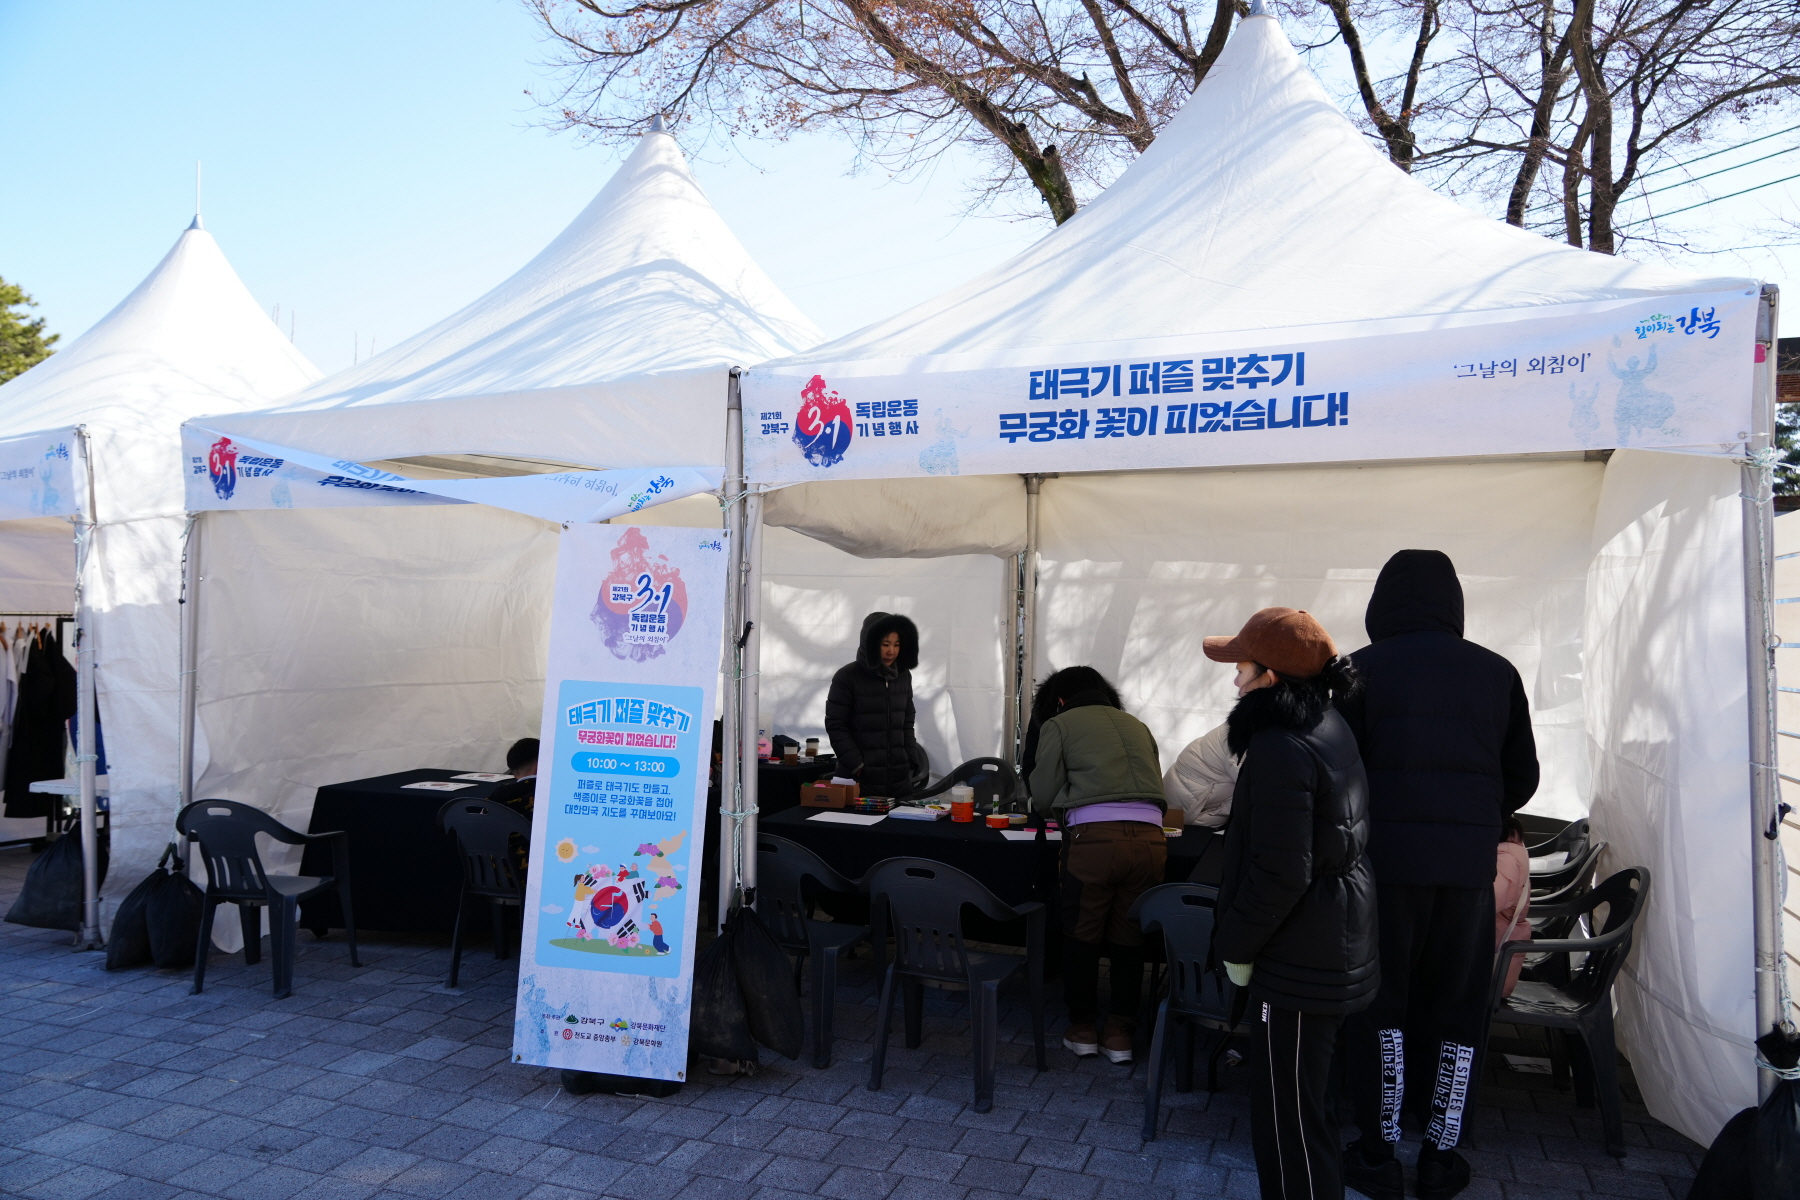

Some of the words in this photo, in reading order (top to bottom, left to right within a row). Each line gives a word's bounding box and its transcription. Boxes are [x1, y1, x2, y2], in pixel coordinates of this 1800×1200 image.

[1676, 307, 1721, 339] 강북
[1029, 365, 1121, 400] 태극기
[1129, 360, 1194, 395] 퍼즐
[1202, 352, 1305, 391] 맞추기
[760, 411, 782, 420] 제21회
[855, 399, 919, 419] 독립운동
[999, 409, 1090, 443] 무궁화
[1094, 405, 1159, 438] 꽃이
[1164, 391, 1349, 434] 피었습니다!
[761, 423, 789, 435] 강북구
[646, 475, 674, 494] 강북
[612, 593, 633, 601] 강북구
[631, 613, 666, 623] 독립운동
[568, 699, 612, 725] 태극기
[614, 698, 645, 724] 퍼즐
[646, 701, 691, 732] 맞추기
[578, 730, 624, 746] 무궁화꽃이
[626, 733, 677, 749] 피었습니다!
[587, 758, 618, 770] 10:00
[634, 761, 666, 773] 13:00
[577, 779, 603, 791] 퍼즐로
[605, 781, 640, 793] 태극기도
[643, 783, 671, 795] 만들고,
[573, 791, 607, 804] 색종이로
[610, 794, 653, 807] 무궁화꽃을
[656, 797, 674, 809] 접어
[564, 804, 599, 816] 대한민국
[601, 806, 627, 818] 지도를
[630, 808, 677, 821] 꾸며보아요!
[580, 1016, 605, 1025] 강북구
[630, 1021, 667, 1033] 강북문화재단
[574, 1031, 592, 1040] 천도교
[633, 1037, 663, 1048] 강북문화원
[1449, 1065, 1468, 1112] STRIPES
